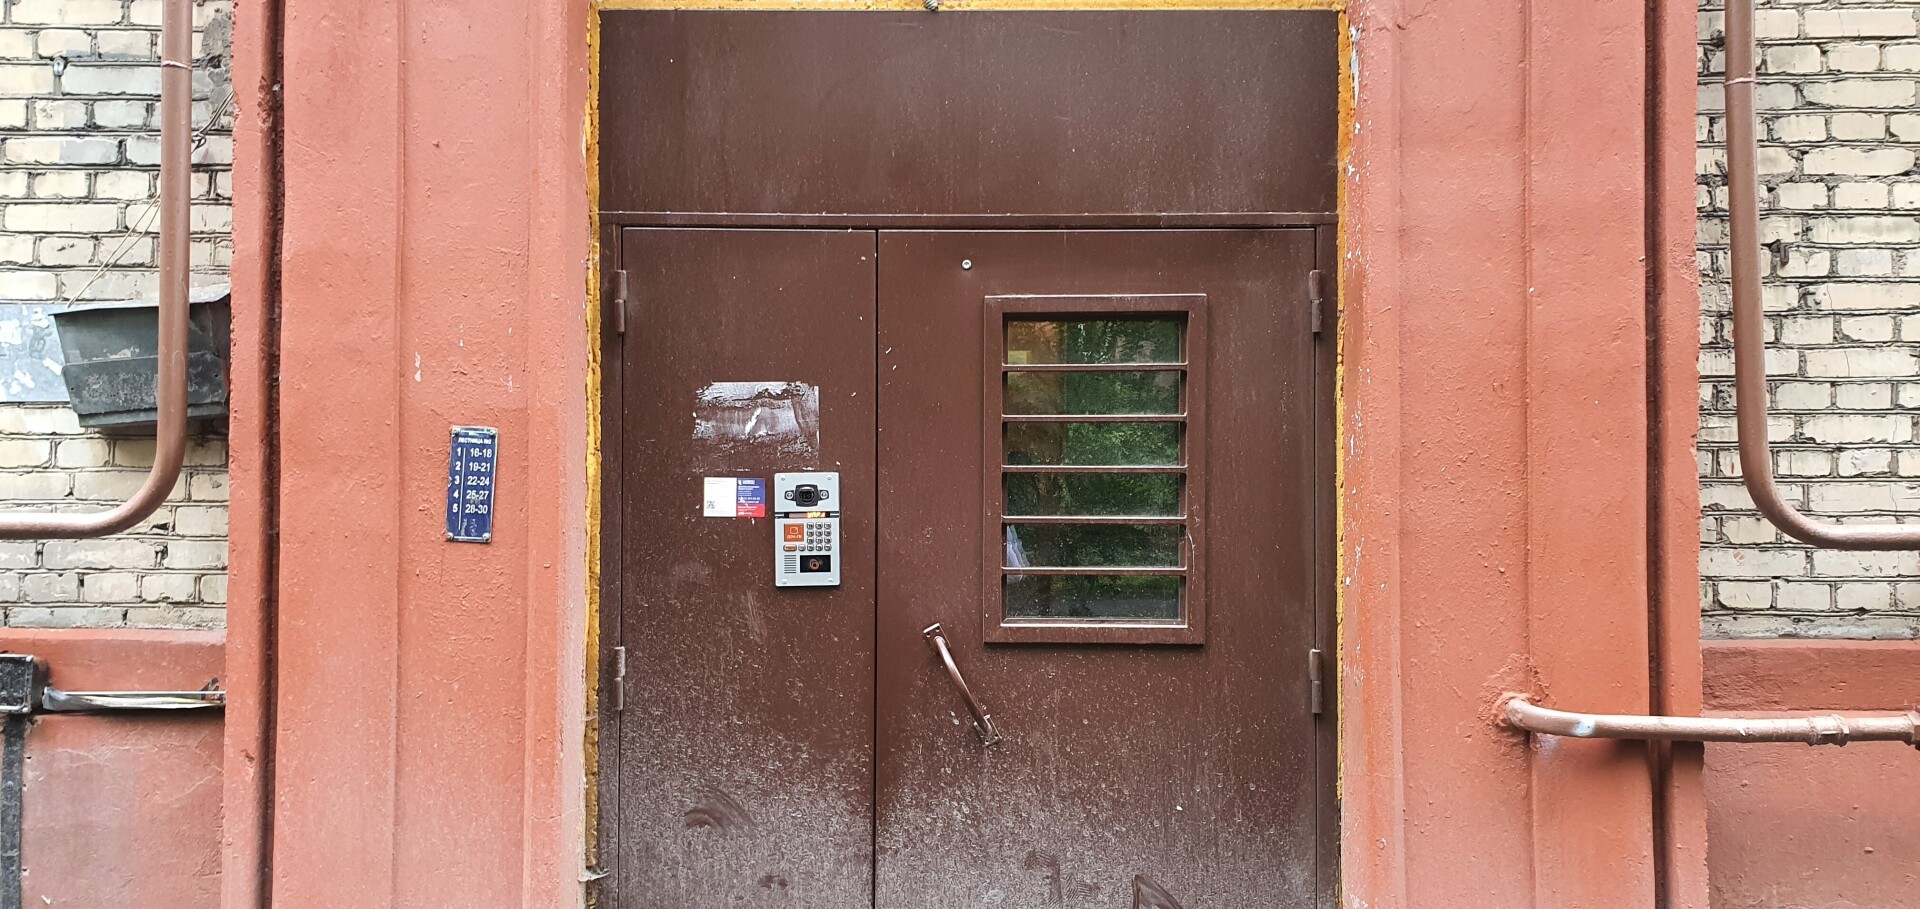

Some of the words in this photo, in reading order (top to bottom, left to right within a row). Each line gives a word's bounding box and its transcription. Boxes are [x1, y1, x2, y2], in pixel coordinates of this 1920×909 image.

[457, 447, 461, 456] 1
[470, 448, 492, 458] 16-18
[455, 461, 461, 470] 2
[469, 462, 490, 472] 19-21
[454, 475, 460, 485] 3
[467, 476, 490, 486] 22-24
[453, 489, 459, 499] 4
[466, 490, 489, 500] 25-27
[452, 503, 458, 513] 5
[464, 504, 488, 514] 28-30
